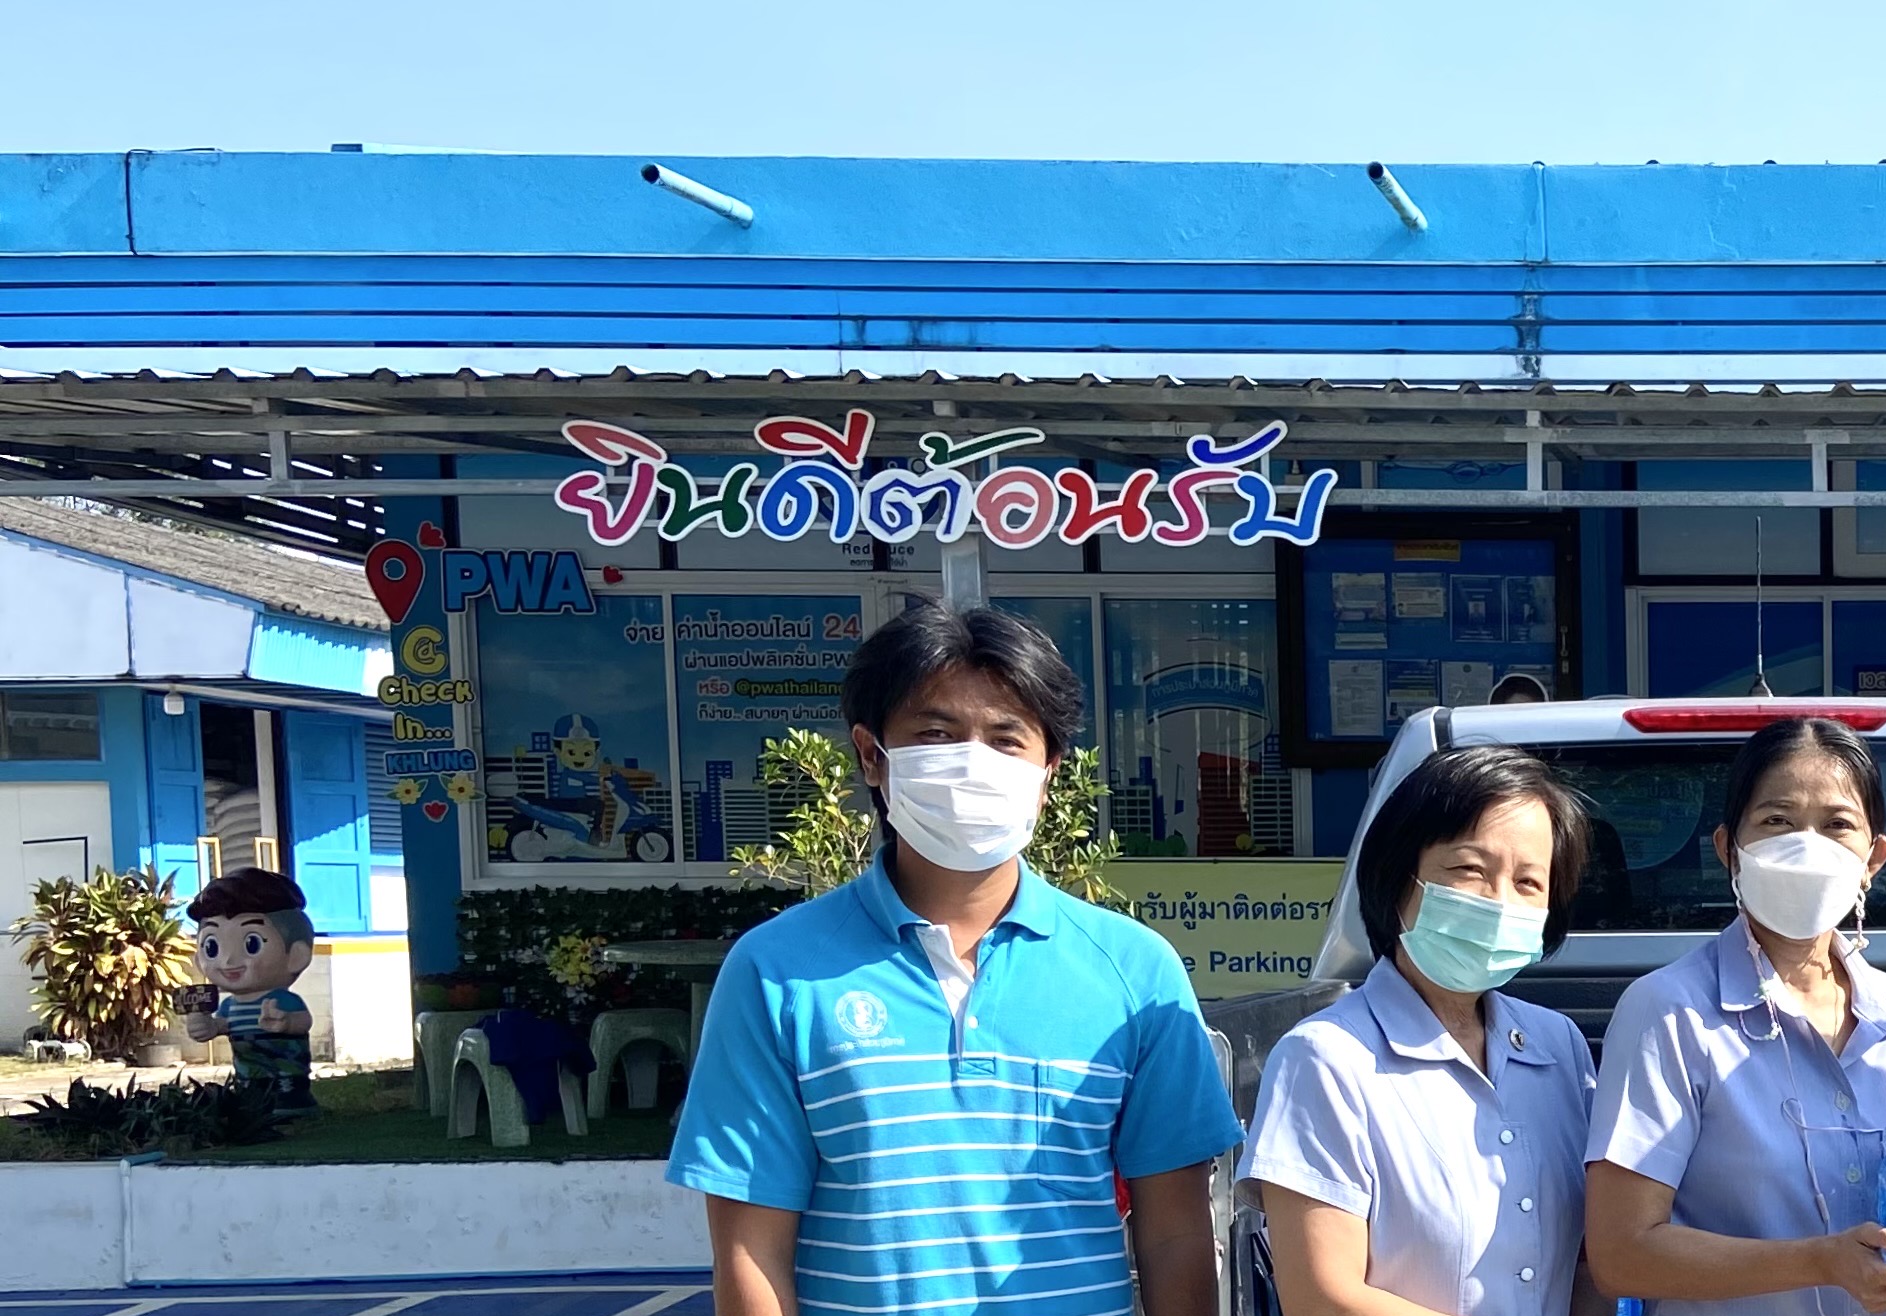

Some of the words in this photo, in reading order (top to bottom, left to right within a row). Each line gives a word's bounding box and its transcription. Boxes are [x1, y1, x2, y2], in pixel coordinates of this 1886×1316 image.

[443, 550, 595, 613] PWA
[822, 613, 861, 640] 24
[821, 652, 848, 668] PW
[377, 674, 475, 706] Check
[384, 750, 476, 776] KHLUNG
[1209, 951, 1312, 978] Parking
